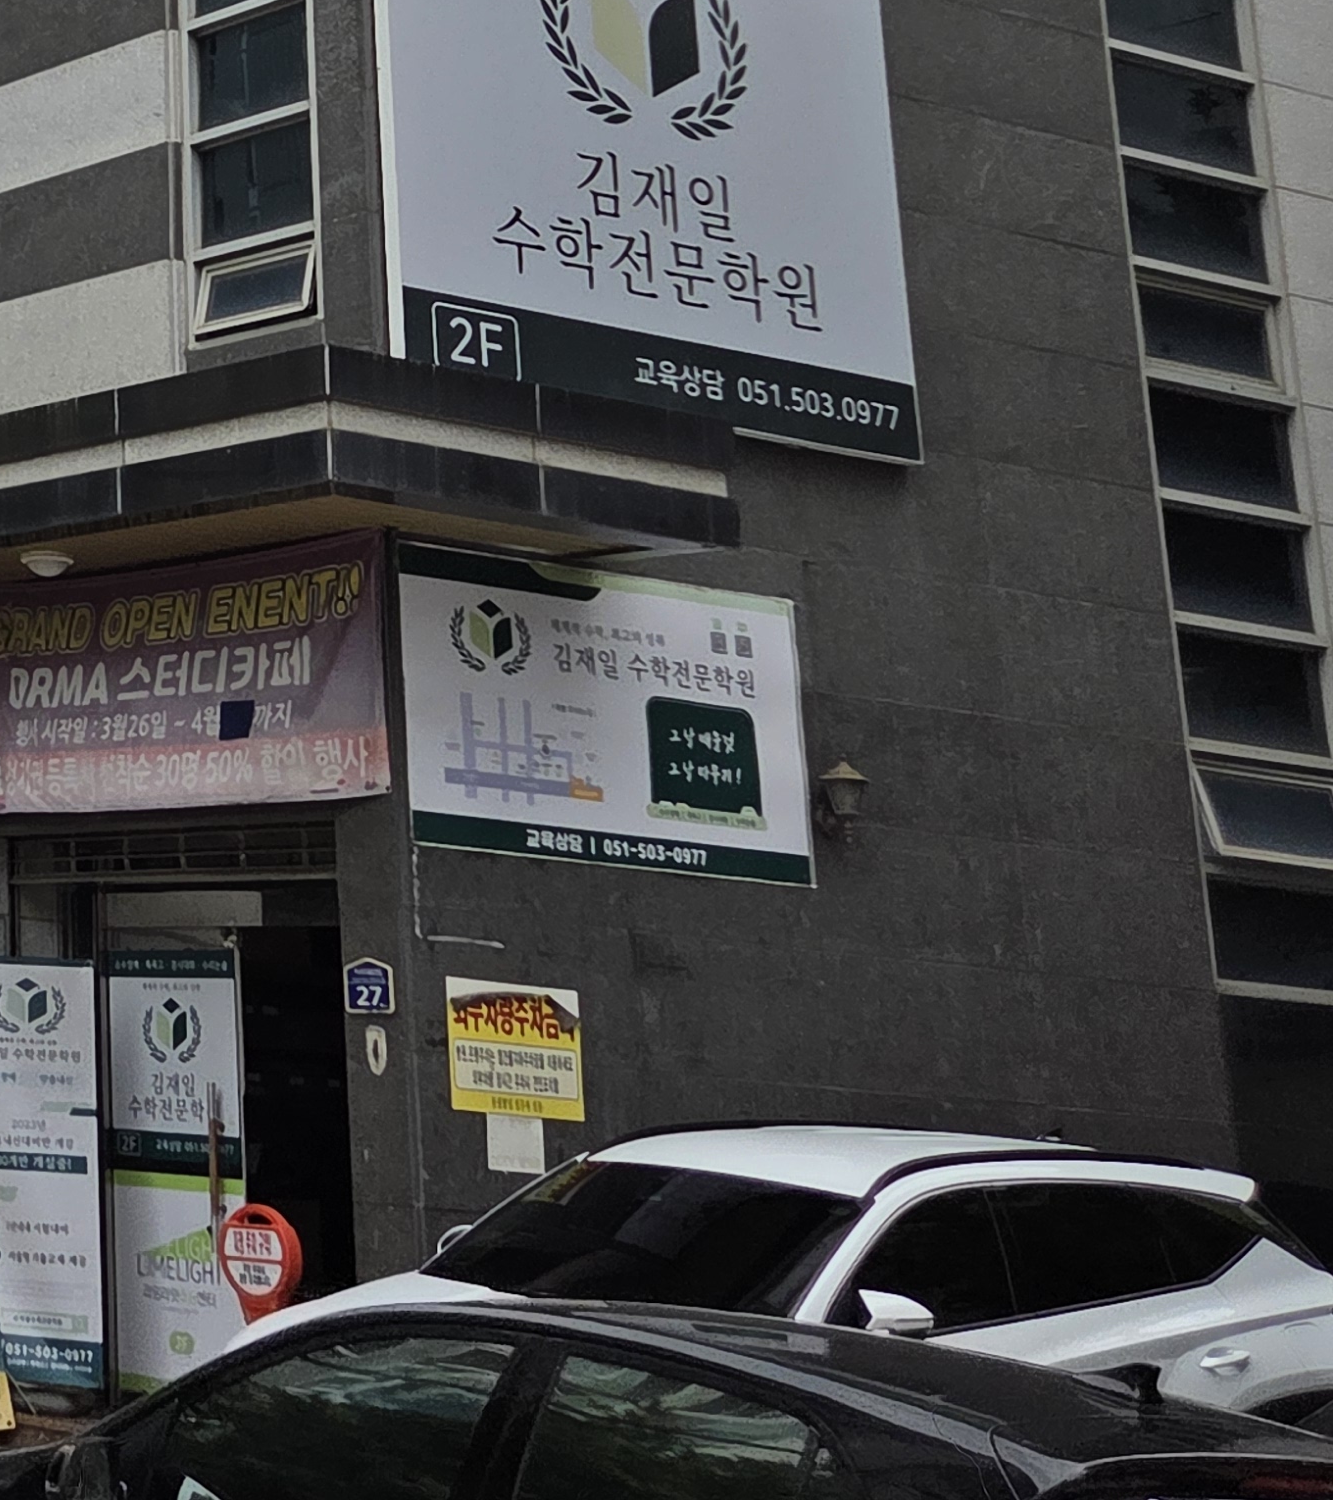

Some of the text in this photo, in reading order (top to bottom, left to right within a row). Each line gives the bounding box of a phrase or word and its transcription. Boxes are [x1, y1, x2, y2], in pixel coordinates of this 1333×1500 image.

[576, 150, 735, 243] 김재일
[493, 206, 823, 332] 수학전문학원
[449, 317, 504, 367] 2F
[634, 357, 899, 431] 교육상담 051.503.0977
[102, 590, 196, 650] OPEN
[117, 635, 311, 700] 스터디카페
[553, 642, 756, 699] 김재일 수학전문학원
[526, 829, 708, 867] 교육상담 051-503-0977
[356, 985, 382, 1006] 27
